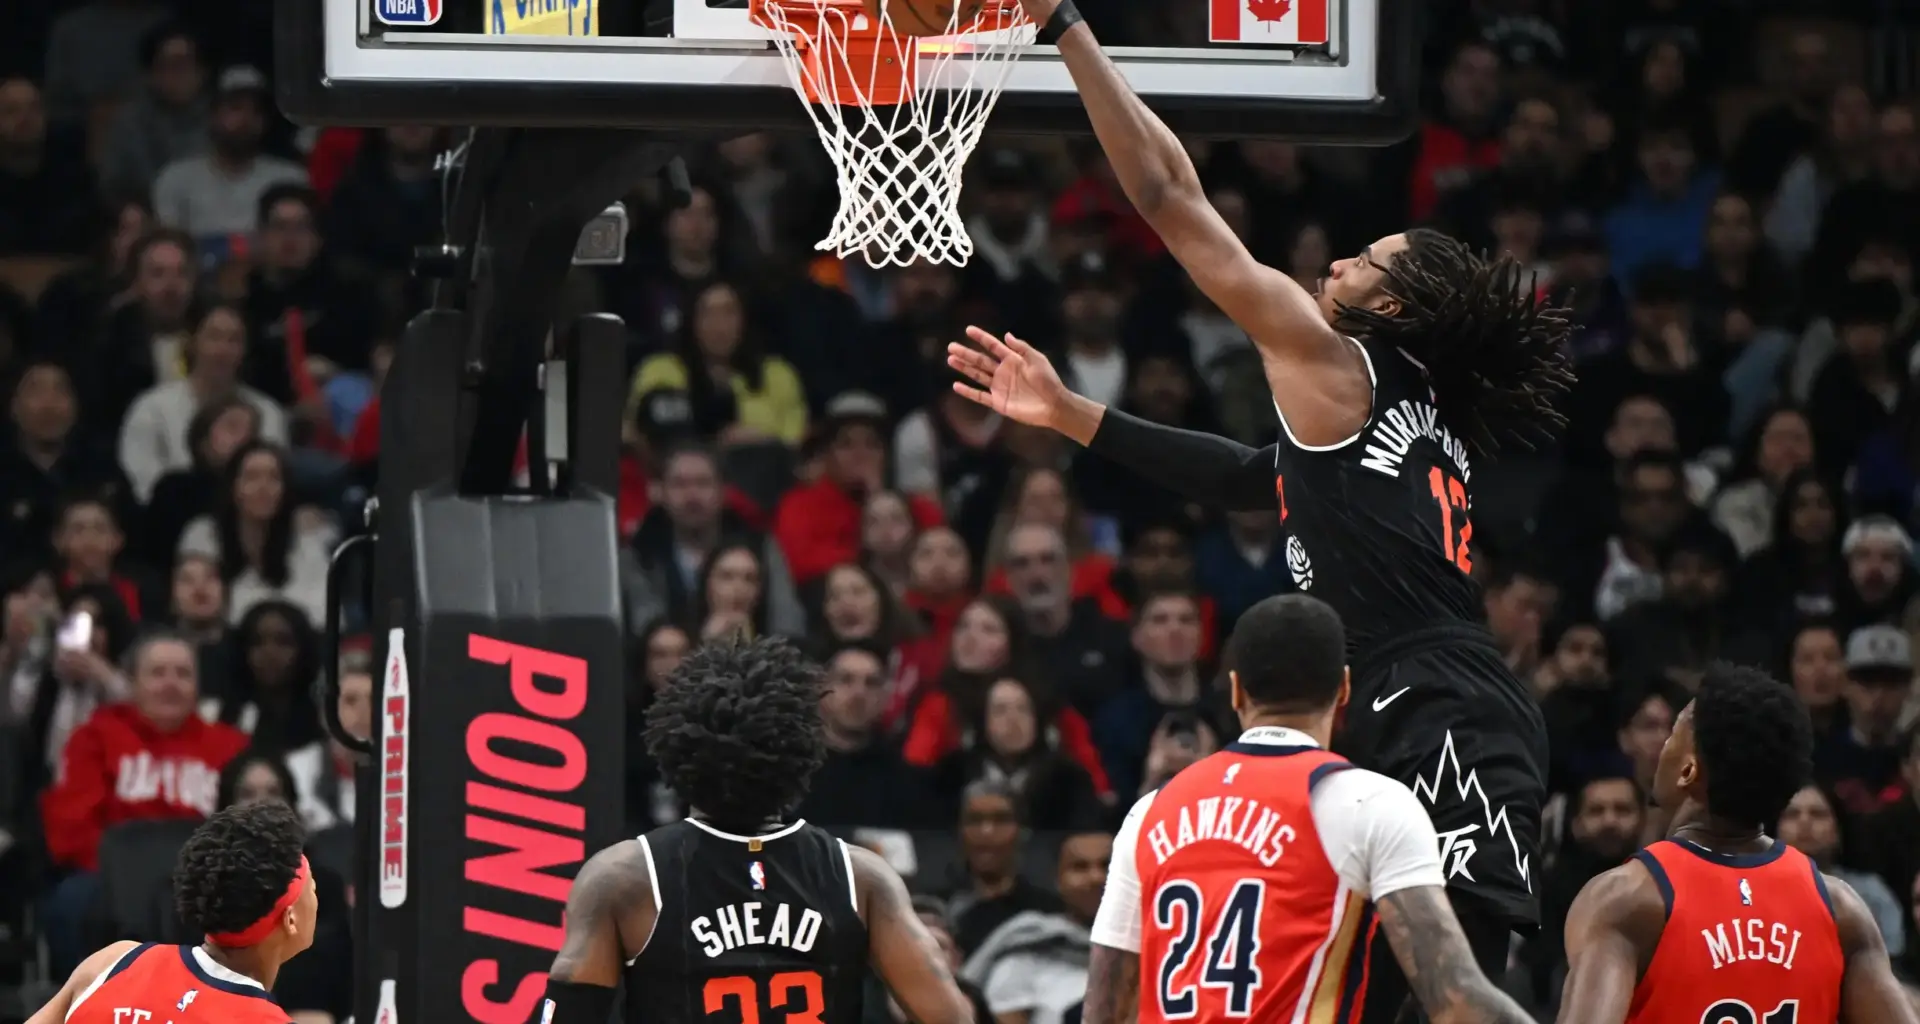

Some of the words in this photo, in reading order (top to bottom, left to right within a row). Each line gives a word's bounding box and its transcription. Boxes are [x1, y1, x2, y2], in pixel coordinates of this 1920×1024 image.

[386, 0, 417, 15] NBA
[1428, 466, 1472, 575] 12
[384, 695, 405, 881] PRIME
[461, 633, 588, 1024] POINTS
[1147, 796, 1296, 867] HAWKINS
[690, 902, 822, 957] SHEAD
[1153, 878, 1266, 1021] 24
[1701, 918, 1802, 970] MISSI
